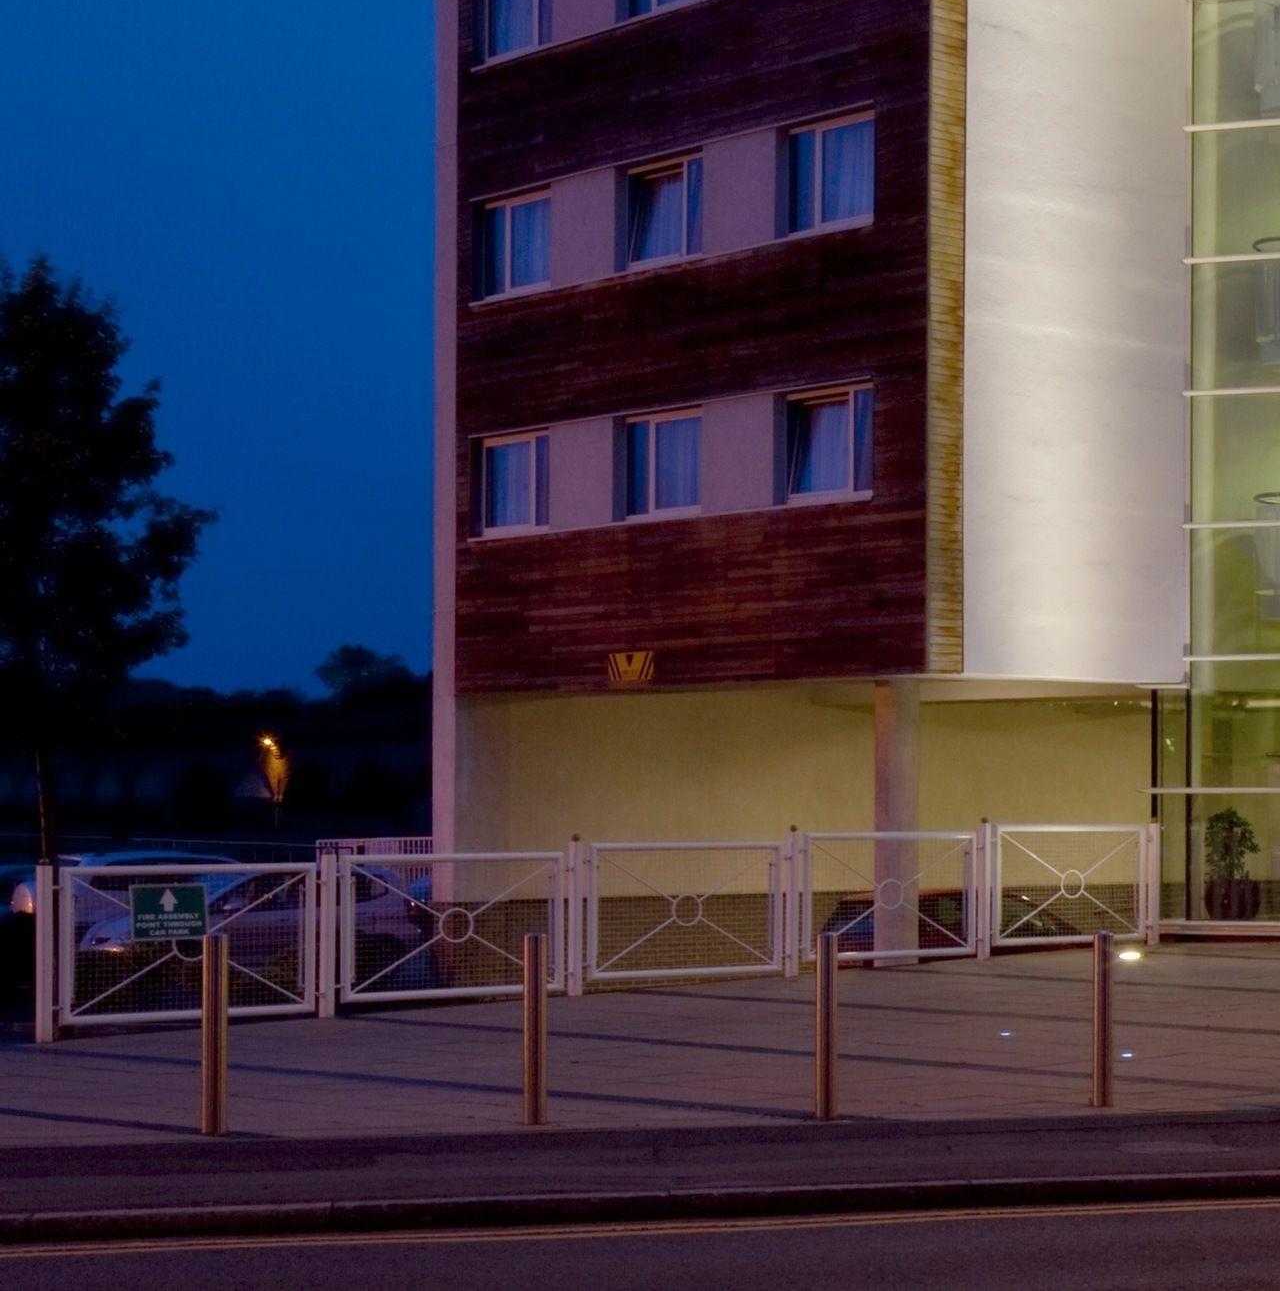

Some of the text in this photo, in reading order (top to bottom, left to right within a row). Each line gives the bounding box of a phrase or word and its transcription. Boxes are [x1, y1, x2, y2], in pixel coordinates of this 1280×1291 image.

[137, 913, 156, 921] FIRE
[136, 920, 202, 929] POINT THROUGH
